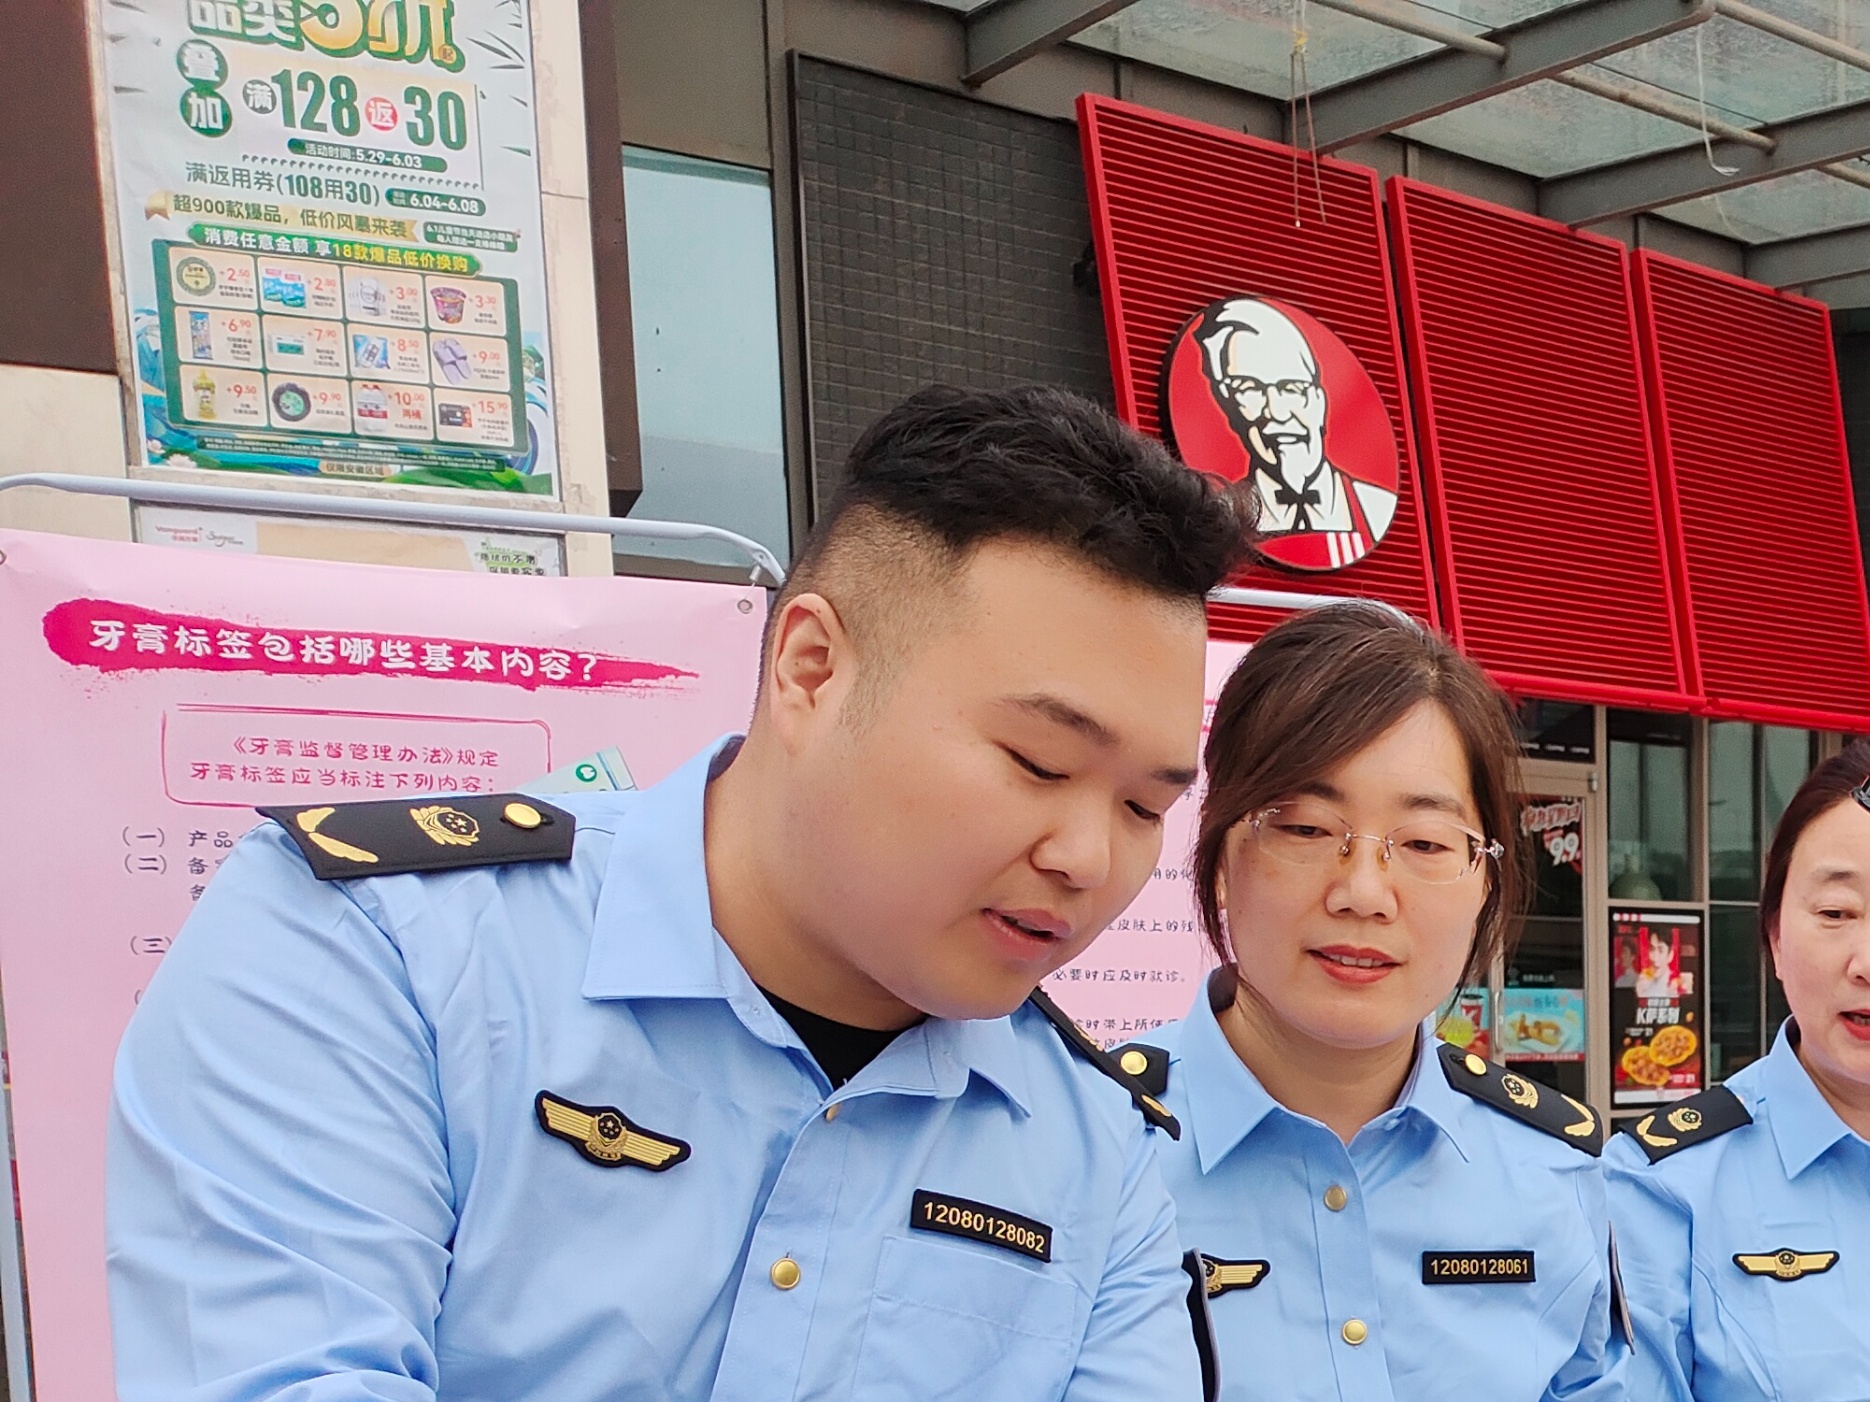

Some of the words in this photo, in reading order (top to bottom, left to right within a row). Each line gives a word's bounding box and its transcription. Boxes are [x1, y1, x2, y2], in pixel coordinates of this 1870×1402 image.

[184, 44, 224, 130] 叠加
[409, 189, 480, 214] 6.04-6.08
[204, 227, 308, 254] 消费任意金额
[89, 618, 599, 682] 牙膏标签包括哪些基本内容？
[232, 736, 500, 768] 《牙膏监督管理办法》规定
[190, 763, 497, 794] 牙膏标签应当标注下列内容：
[188, 829, 246, 849] 产品
[923, 1200, 1046, 1253] 12080128082
[1430, 1256, 1530, 1276] 12080128061
